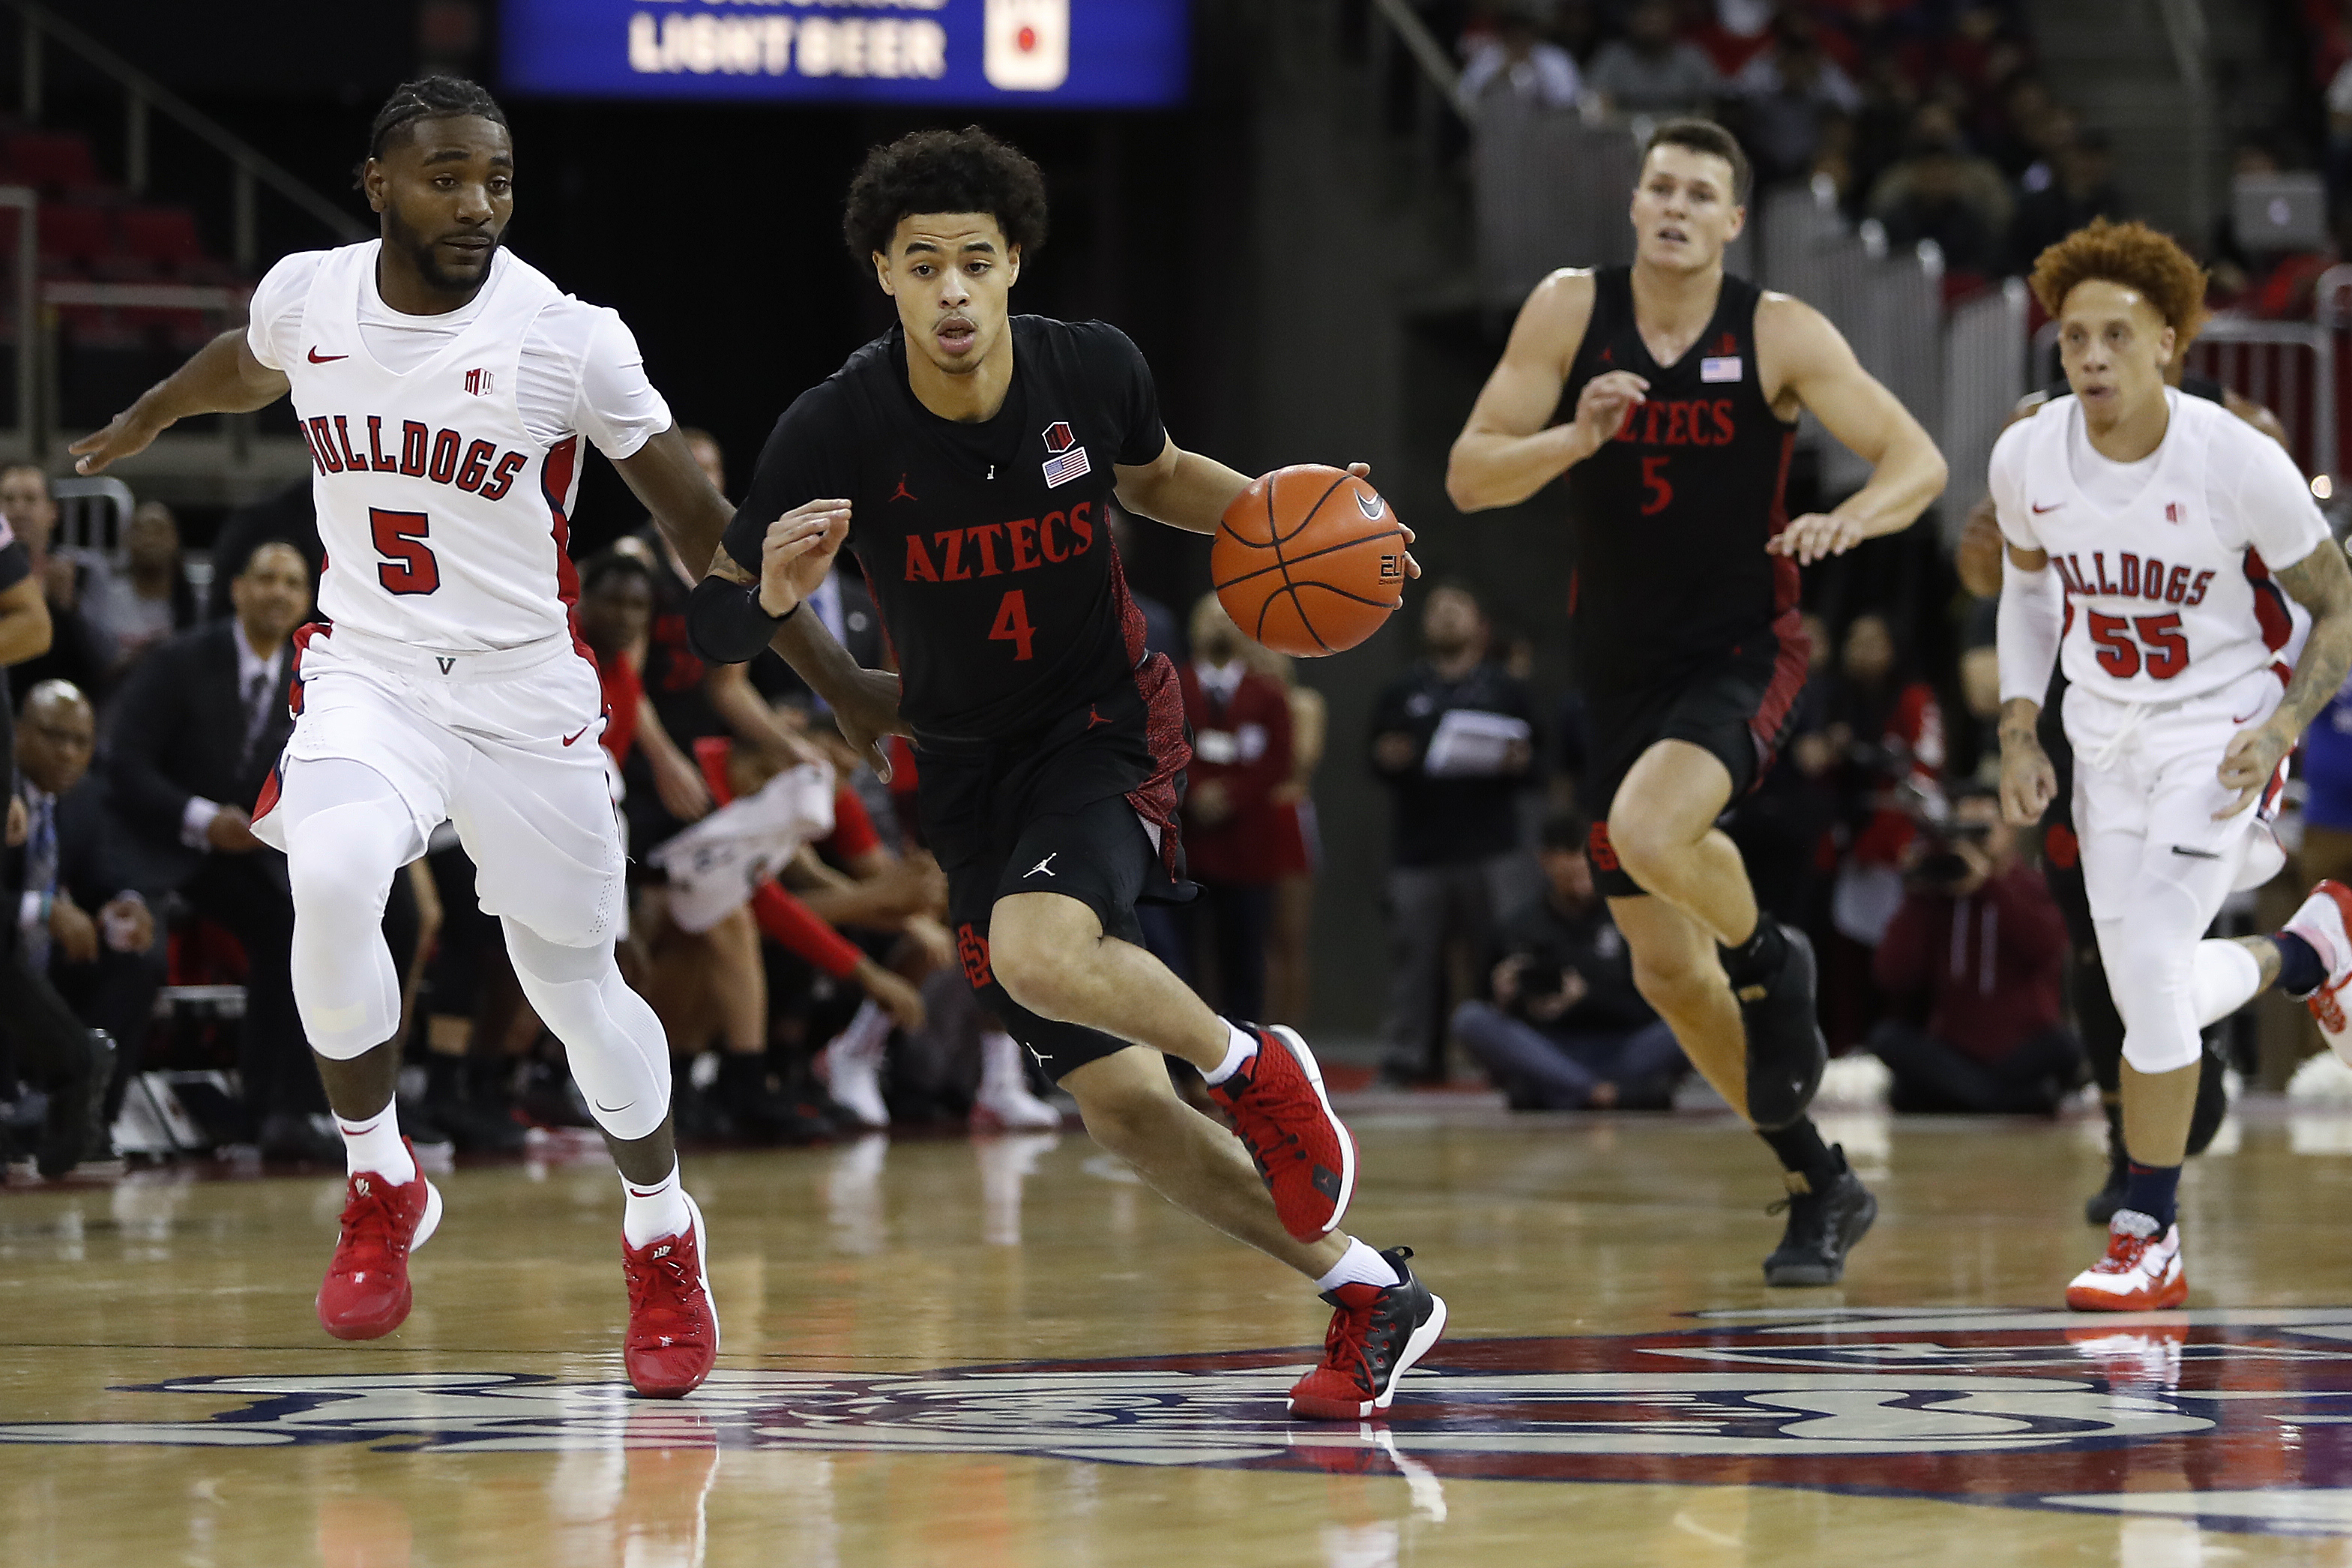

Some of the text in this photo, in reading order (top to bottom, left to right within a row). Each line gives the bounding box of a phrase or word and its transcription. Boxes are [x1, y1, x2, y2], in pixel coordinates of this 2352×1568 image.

[629, 11, 947, 79] LIGHT BEER
[1613, 399, 1735, 446] ZTECS
[1641, 456, 1674, 516] 5
[369, 507, 441, 595] 5
[904, 501, 1094, 582] AZTECS
[2051, 552, 2216, 606] LLDOGS
[988, 589, 1037, 661] 4
[2087, 607, 2189, 680] 55
